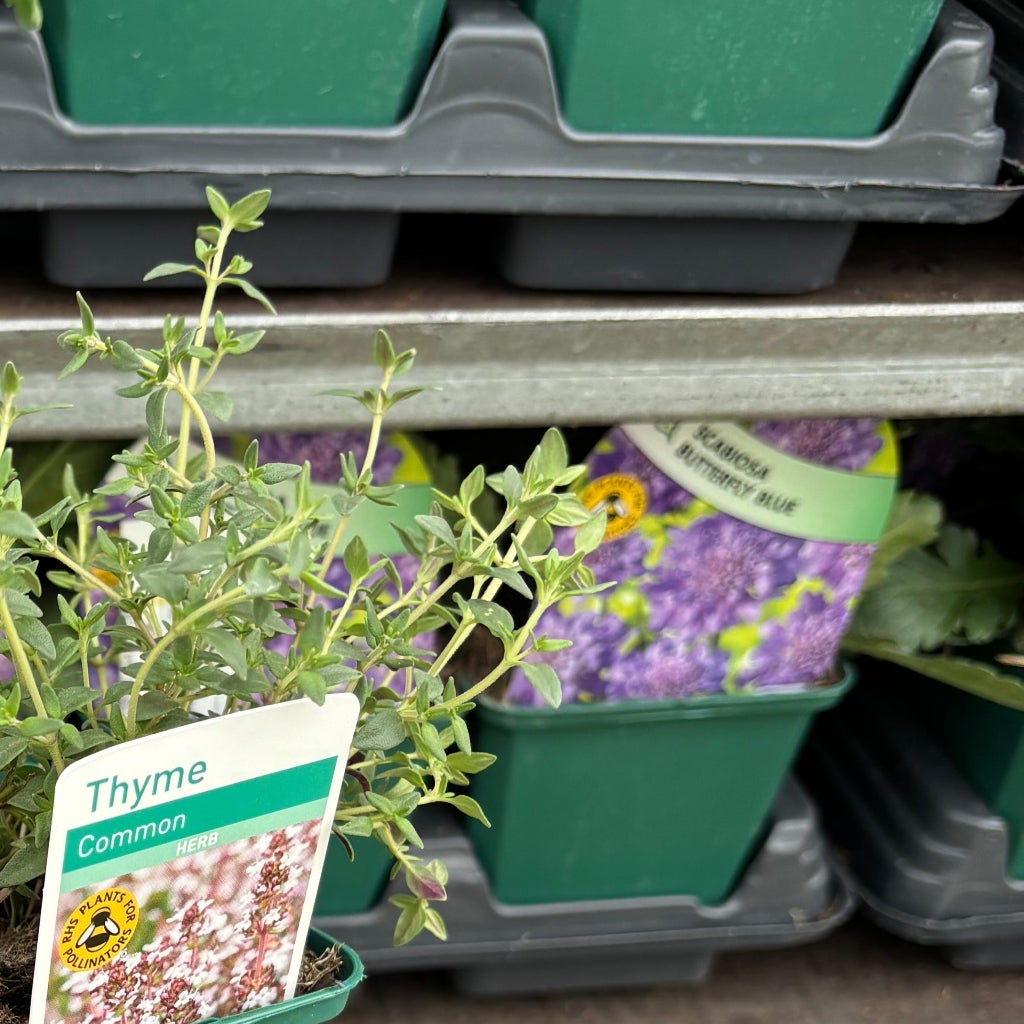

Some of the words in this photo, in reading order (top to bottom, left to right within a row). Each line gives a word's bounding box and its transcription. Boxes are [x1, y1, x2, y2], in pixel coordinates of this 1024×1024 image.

[692, 425, 770, 480] SCABIOSA
[677, 443, 755, 496] BUTTERFLY
[754, 489, 799, 516] BLUE
[87, 760, 207, 813] Thyme
[78, 813, 186, 859] Common
[175, 831, 219, 857] HERB
[62, 918, 79, 944] RHS
[79, 891, 126, 915] PLANTS
[123, 900, 136, 924] FOR
[63, 928, 132, 969] POLLINATORS
